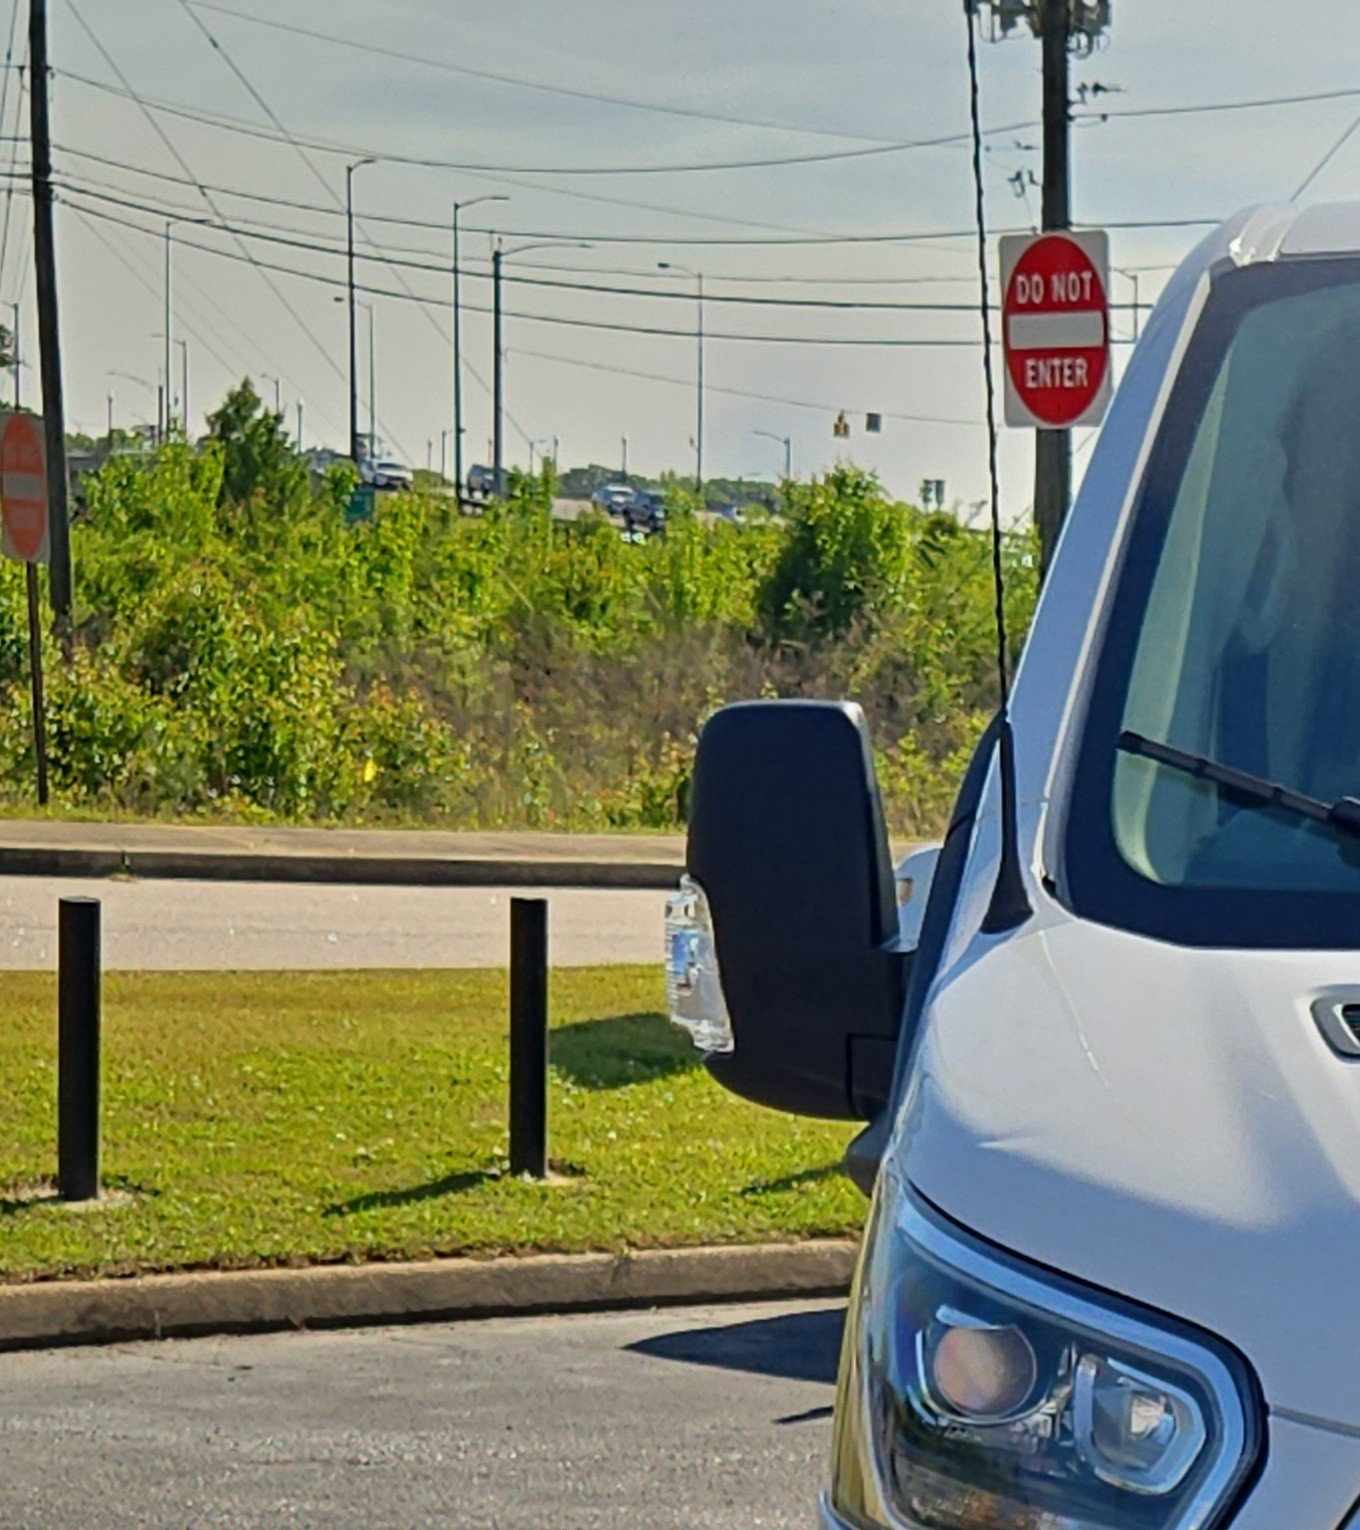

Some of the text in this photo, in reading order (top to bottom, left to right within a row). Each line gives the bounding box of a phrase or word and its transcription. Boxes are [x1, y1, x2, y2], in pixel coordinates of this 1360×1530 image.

[1016, 270, 1093, 304] DO NOT
[1025, 358, 1088, 388] ENTER
